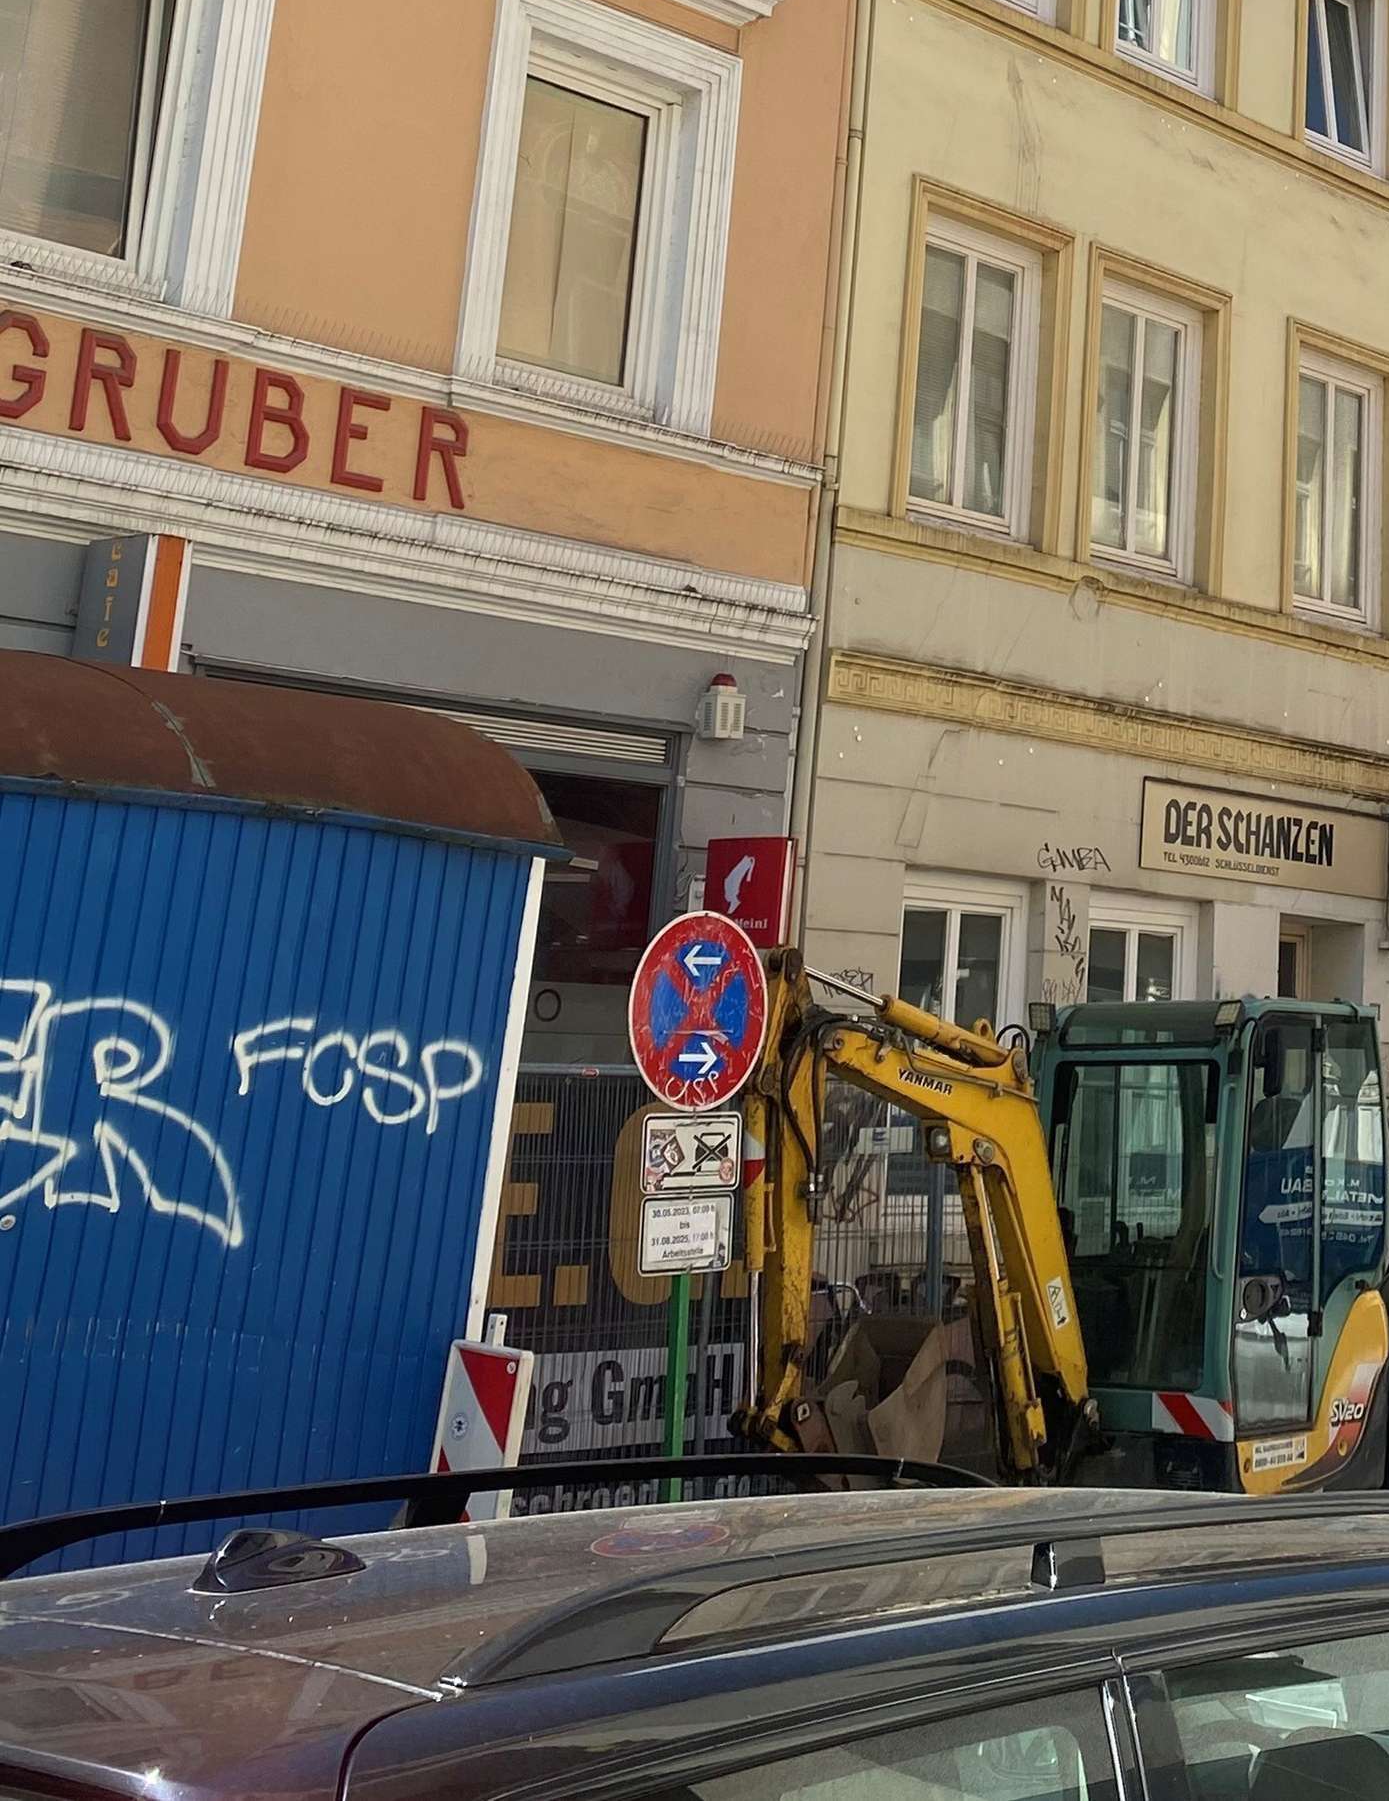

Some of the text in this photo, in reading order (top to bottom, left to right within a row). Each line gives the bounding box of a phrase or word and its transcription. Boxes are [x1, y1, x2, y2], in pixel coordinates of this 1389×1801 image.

[0, 309, 469, 511] GRUBER
[1163, 798, 1335, 867] DER SCHANZEN
[231, 1017, 483, 1135] FCSP
[898, 1066, 954, 1096] YANMAR
[590, 1352, 737, 1426] GmH
[1330, 1397, 1365, 1424] SV20
